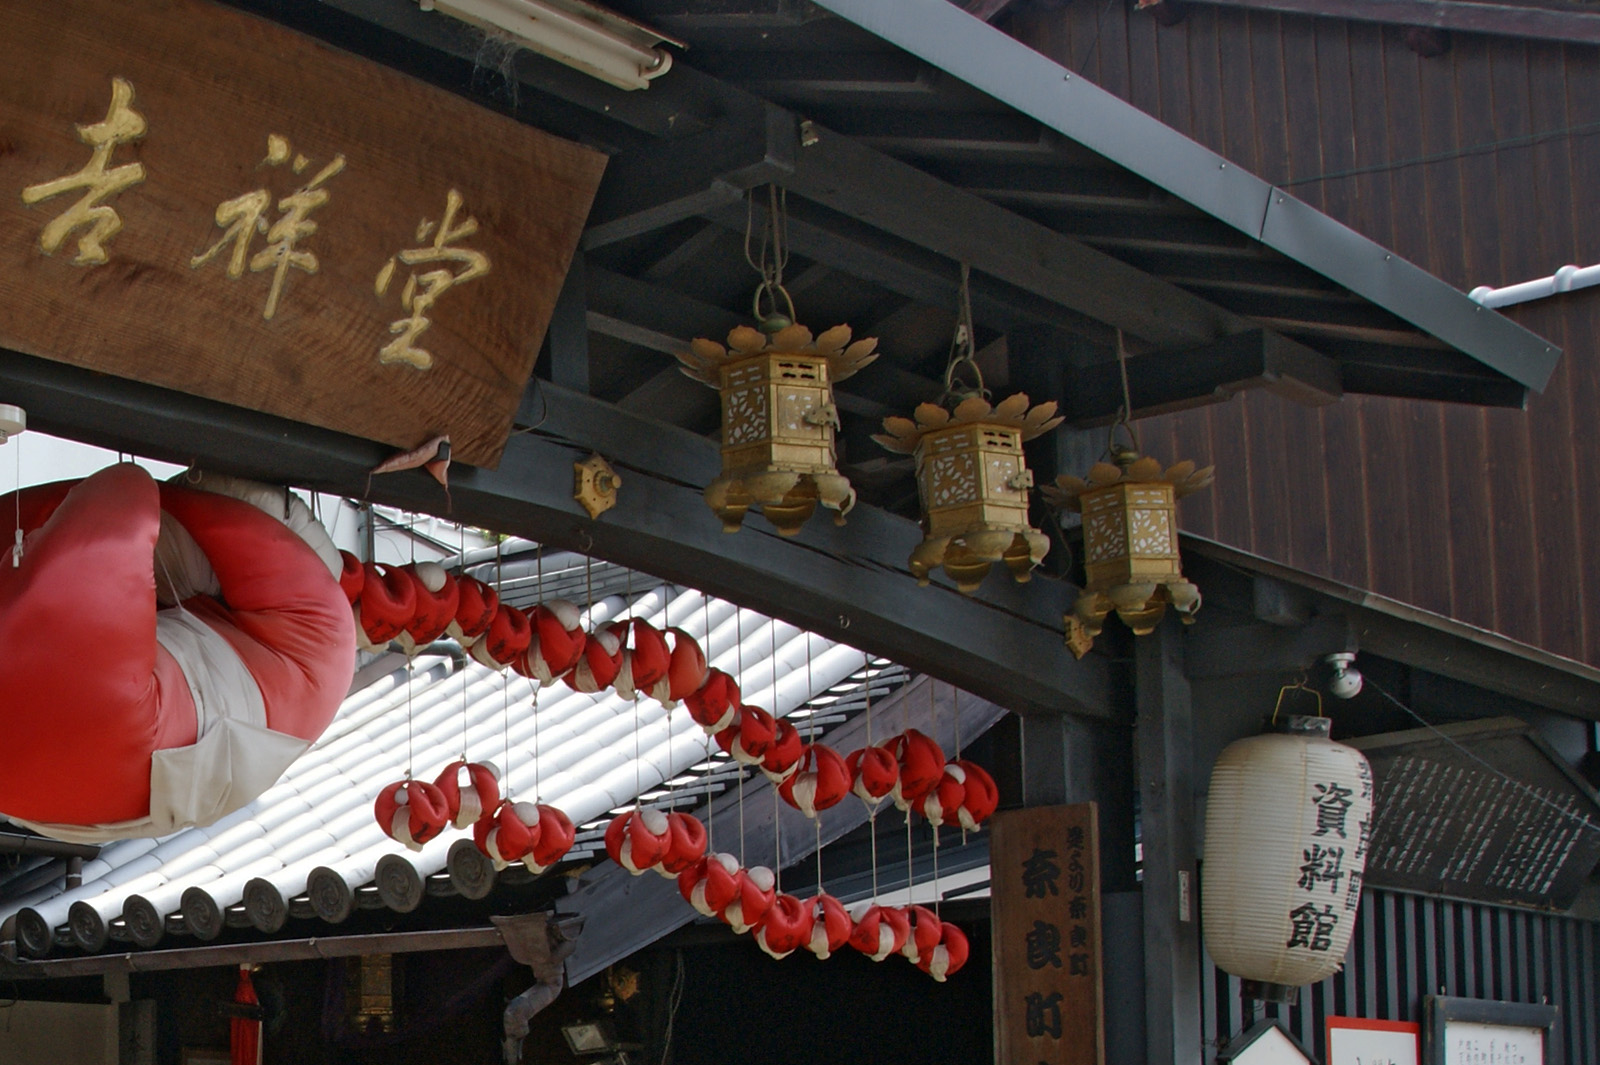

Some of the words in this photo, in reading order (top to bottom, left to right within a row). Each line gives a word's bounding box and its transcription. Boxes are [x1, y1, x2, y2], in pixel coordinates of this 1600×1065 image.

[21, 76, 489, 371] 吉祥堂
[1286, 782, 1354, 952] 資料館
